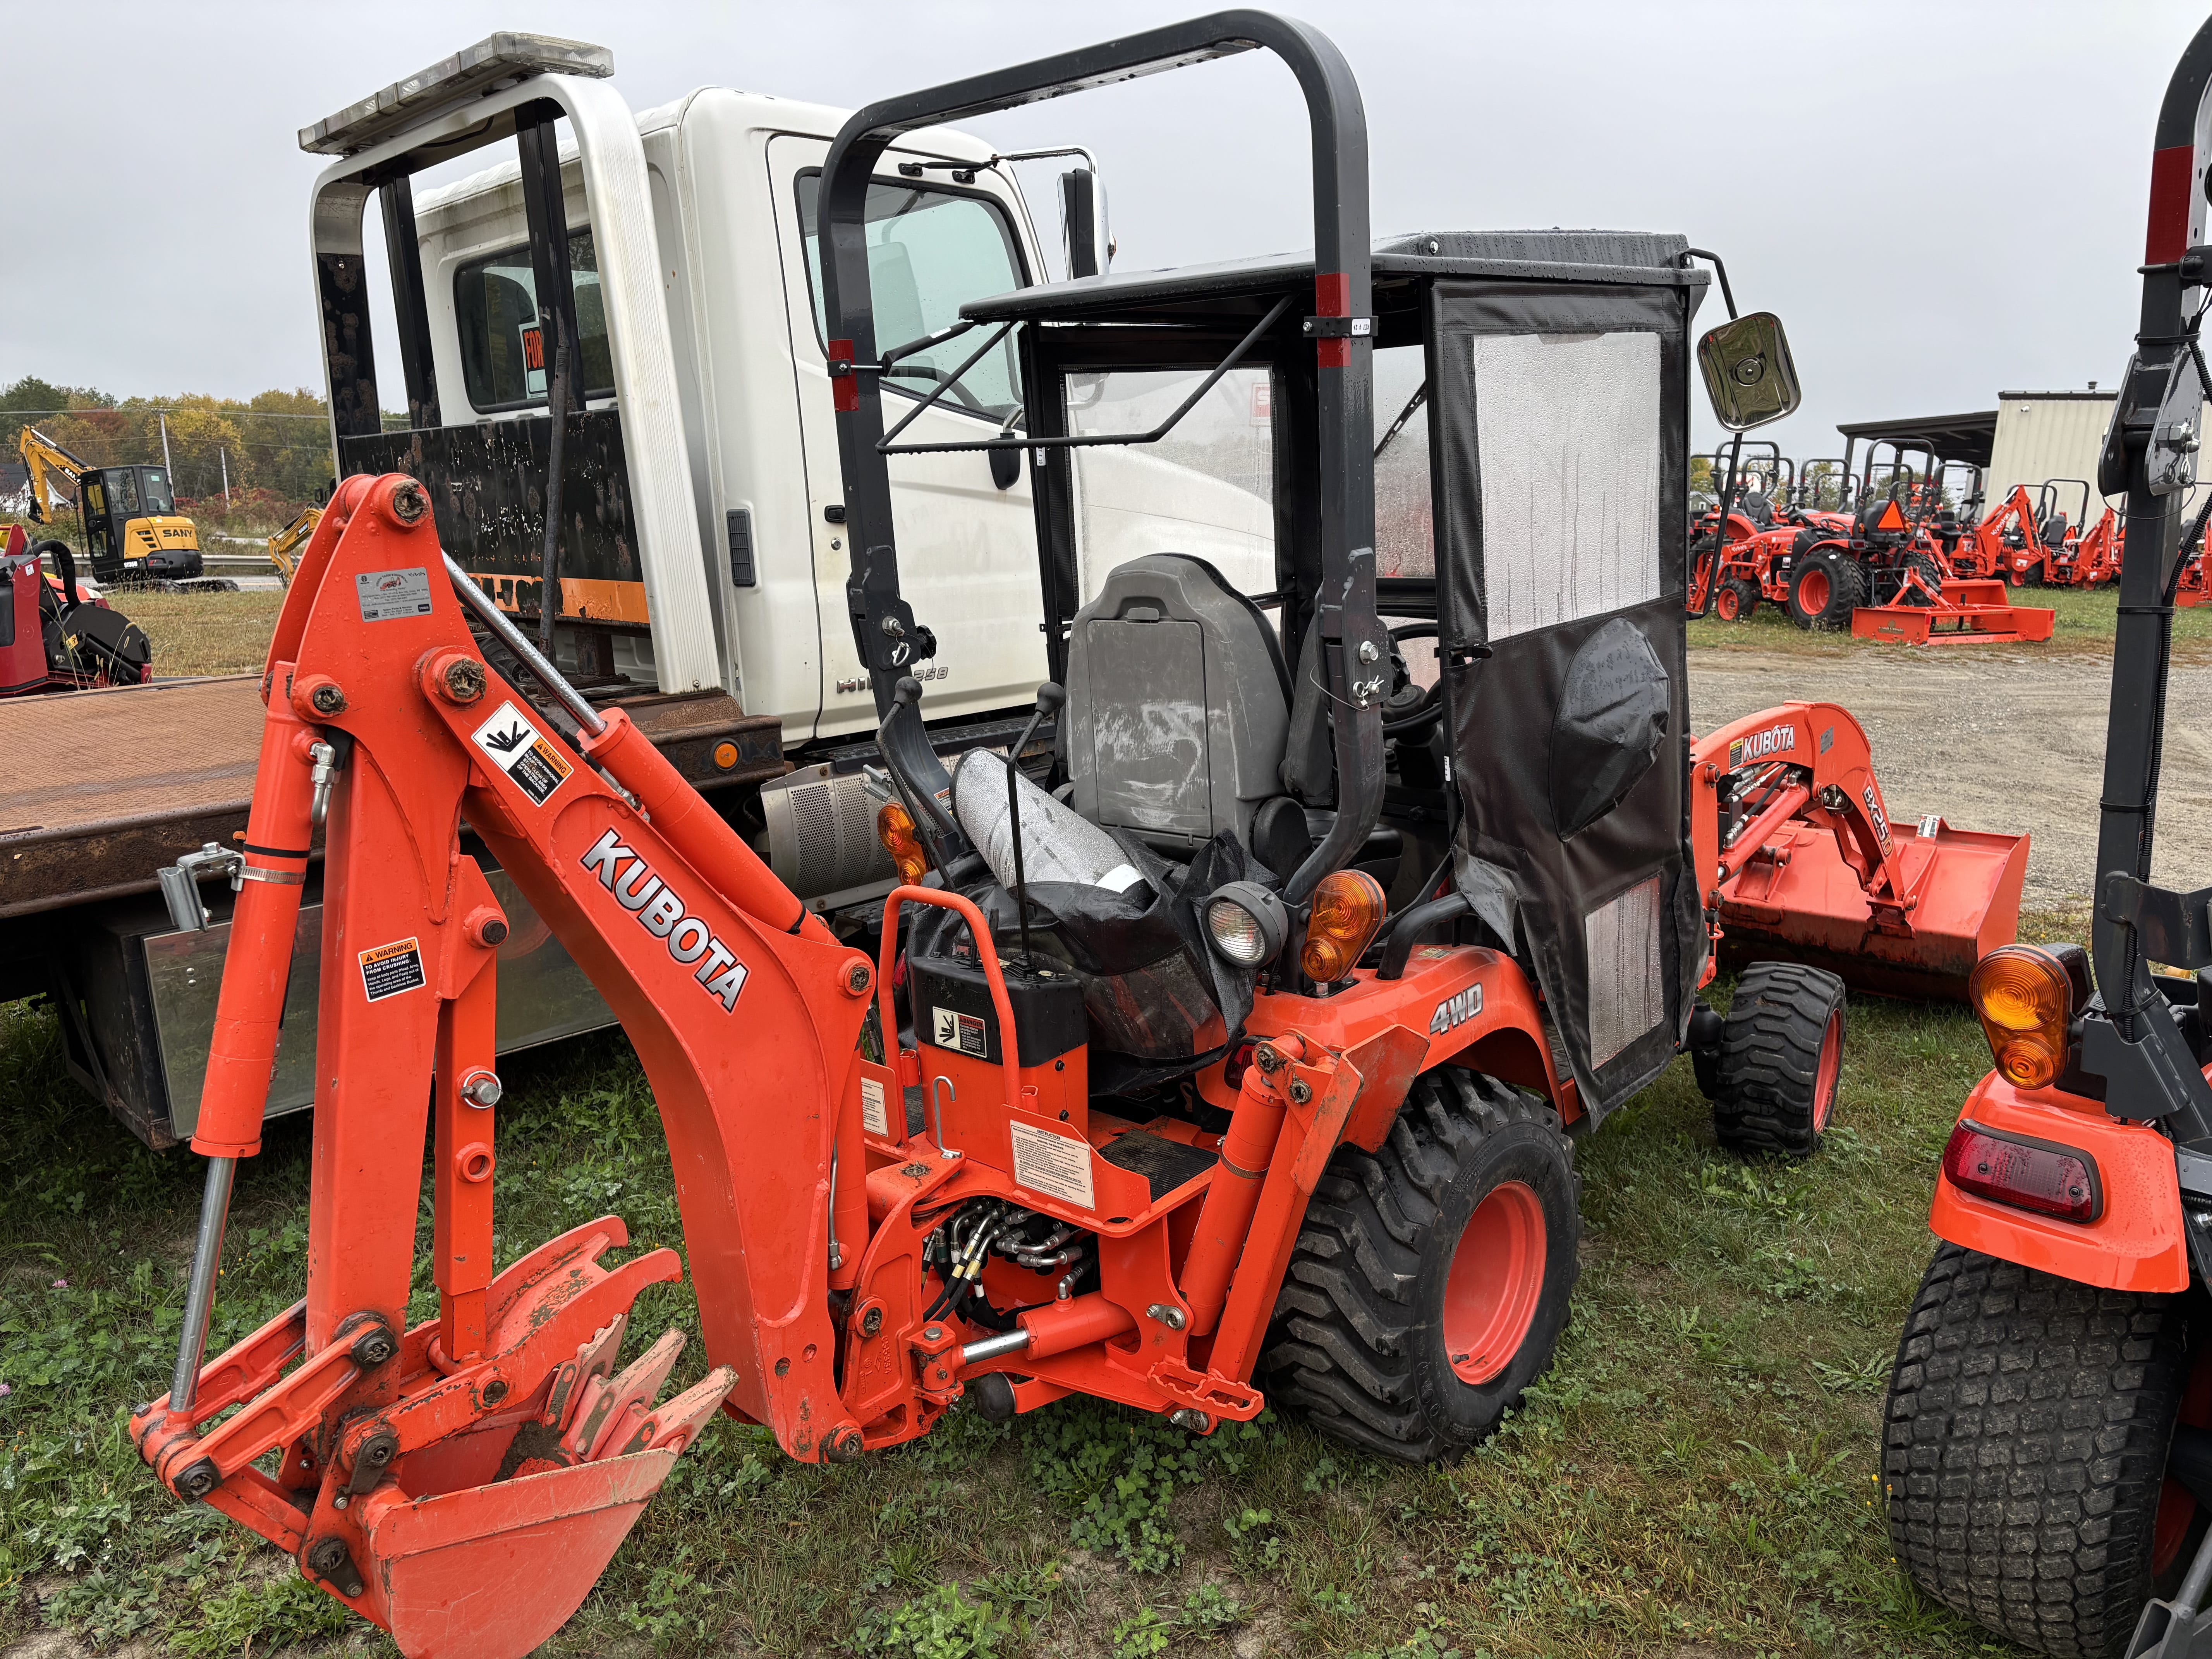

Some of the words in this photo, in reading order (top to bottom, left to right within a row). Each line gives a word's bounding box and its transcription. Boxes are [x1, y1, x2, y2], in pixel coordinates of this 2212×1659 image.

[524, 330, 544, 368] FOR
[163, 529, 192, 538] SANY
[914, 666, 948, 681] 258
[1743, 725, 1795, 763] KUBOTA
[532, 755, 543, 767] AVOID
[542, 765, 559, 784] PERSONAL
[543, 747, 567, 774] WARNING
[520, 761, 539, 782] OPERATING
[538, 780, 548, 790] AREA
[532, 767, 543, 779] CLEAR
[1862, 784, 1893, 857] BX25D
[580, 828, 749, 1013] KUBOTA
[374, 960, 390, 968] AVOID
[391, 954, 409, 963] INJURY
[375, 943, 413, 958] WARNING
[383, 959, 411, 970] CRUSHING:
[1430, 982, 1483, 1036] 4WD
[964, 1019, 982, 1027] DANGER
[1037, 1129, 1061, 1140] INSTRUCTION
